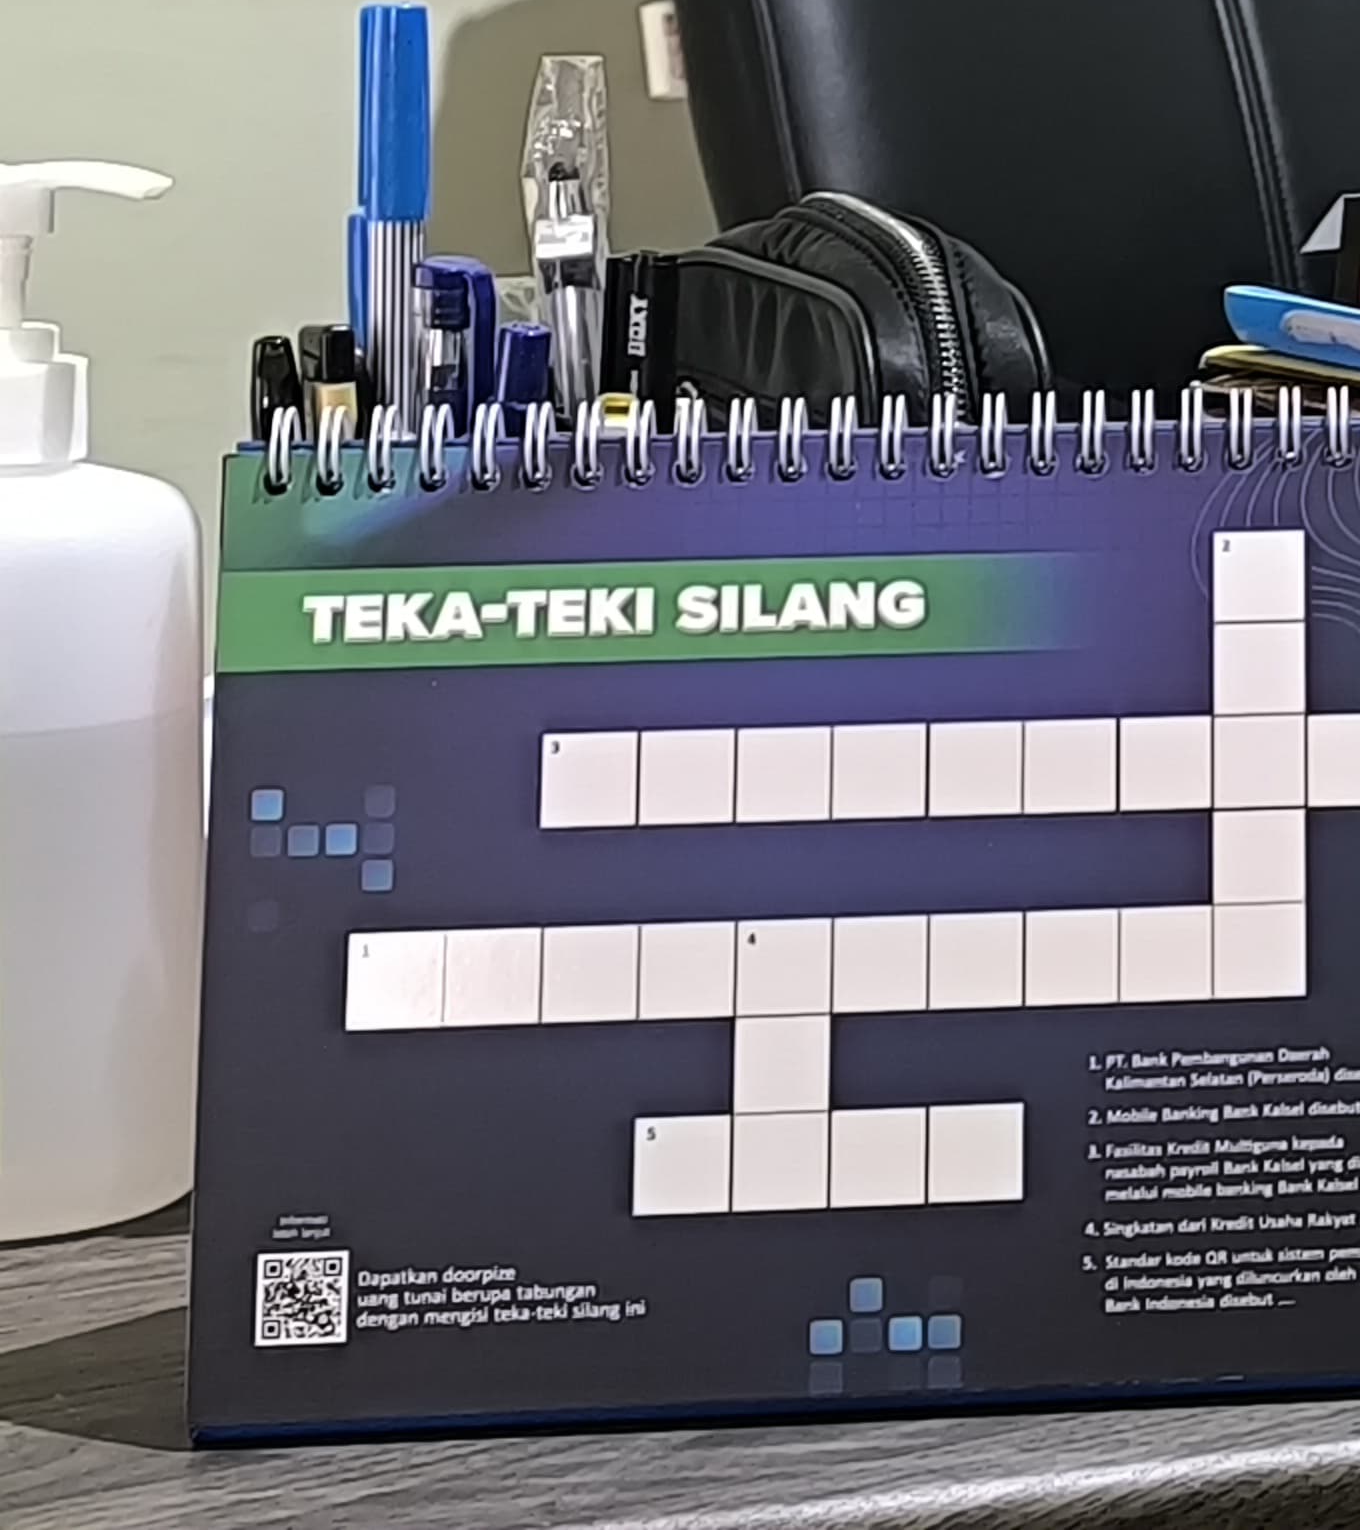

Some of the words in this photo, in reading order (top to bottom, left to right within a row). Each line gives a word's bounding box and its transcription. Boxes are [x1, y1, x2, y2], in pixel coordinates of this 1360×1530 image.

[302, 587, 654, 644] TEKA-TEKI
[676, 579, 925, 633] SILANG
[1131, 1052, 1168, 1069] Bank
[1171, 1050, 1274, 1067] Pembangunan
[1278, 1046, 1330, 1062] Daerah
[1105, 1074, 1186, 1090] Kalimantan
[1190, 1072, 1244, 1088] Selatan
[1106, 1108, 1158, 1124] Mobile
[1161, 1106, 1219, 1123] Banking
[1223, 1104, 1259, 1119] Bank
[1262, 1101, 1304, 1118] Kalsel
[1105, 1143, 1162, 1158] Fasilitas
[1167, 1140, 1210, 1156] Kredit
[1105, 1163, 1166, 1180] nasabah
[1169, 1161, 1218, 1180] payroll
[1223, 1160, 1258, 1175] Bank
[1263, 1157, 1305, 1172] Kalsel
[1308, 1159, 1344, 1174] yang
[1105, 1186, 1158, 1201] melalui
[1162, 1183, 1212, 1199] mobile
[1216, 1181, 1273, 1198] banking
[1277, 1179, 1313, 1194] Bank
[1317, 1177, 1359, 1192] Kalsel
[1103, 1220, 1174, 1238] Singkatan
[1177, 1218, 1206, 1233] dari
[1210, 1216, 1254, 1231] Kredit
[1259, 1214, 1303, 1230] Usaha
[1307, 1212, 1356, 1229] Rakyat
[1105, 1252, 1161, 1270] Standar
[1165, 1251, 1201, 1267] kode
[1205, 1250, 1227, 1265] QR
[1231, 1247, 1273, 1263] untuk
[1278, 1246, 1325, 1262] sistem
[357, 1268, 438, 1290] Dapatkan
[1104, 1276, 1119, 1291] di
[1123, 1275, 1192, 1290] Indonesia
[1197, 1275, 1232, 1290] yang
[1325, 1266, 1357, 1282] oleh
[357, 1293, 399, 1310] uang
[404, 1288, 447, 1305] tunai
[451, 1287, 511, 1305] berupa
[516, 1284, 596, 1302] tabungan
[1105, 1296, 1140, 1313] Bank
[1145, 1295, 1215, 1310] Indonesia
[1219, 1292, 1273, 1308] disebut
[356, 1311, 419, 1331] dengan
[423, 1306, 488, 1327] mengisi
[494, 1302, 567, 1322] teka-teki
[571, 1302, 621, 1320] silang
[625, 1299, 646, 1317] ini
